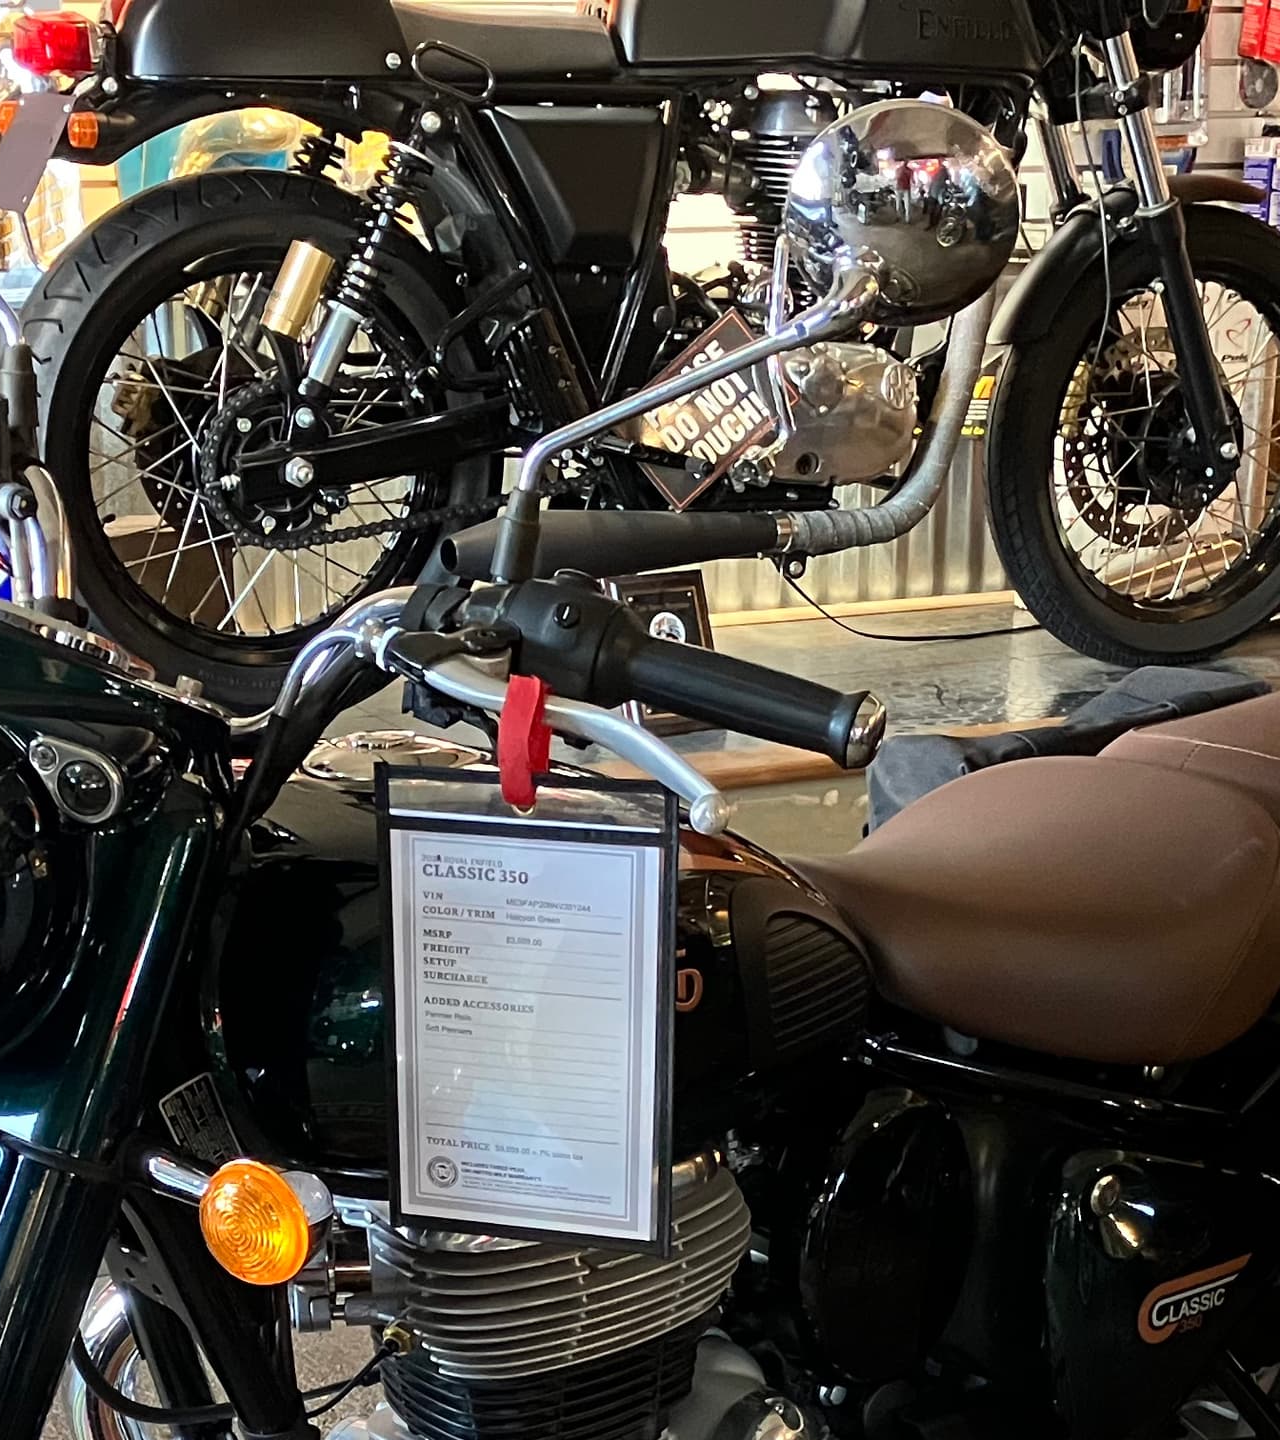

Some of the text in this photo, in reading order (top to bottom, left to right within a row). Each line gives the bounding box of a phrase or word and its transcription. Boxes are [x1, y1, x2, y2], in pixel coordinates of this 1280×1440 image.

[661, 372, 749, 454] DO NOT
[685, 390, 771, 465] OUCH!
[470, 858, 503, 868] ENFIELD
[422, 863, 529, 885] CLASSIC 350
[423, 891, 444, 901] VIN
[422, 905, 460, 917] COLOR
[466, 911, 496, 920] TRIM
[423, 929, 453, 940] MSRP
[422, 943, 471, 956] FREIGHT
[423, 957, 457, 968] SETUP
[423, 971, 489, 985] SURCHARGE
[423, 996, 535, 1014] ADDED ACCESSORIES
[426, 1136, 460, 1148] TOTAL
[460, 1140, 491, 1152] PRICE
[1151, 1284, 1226, 1328] CLASSIC
